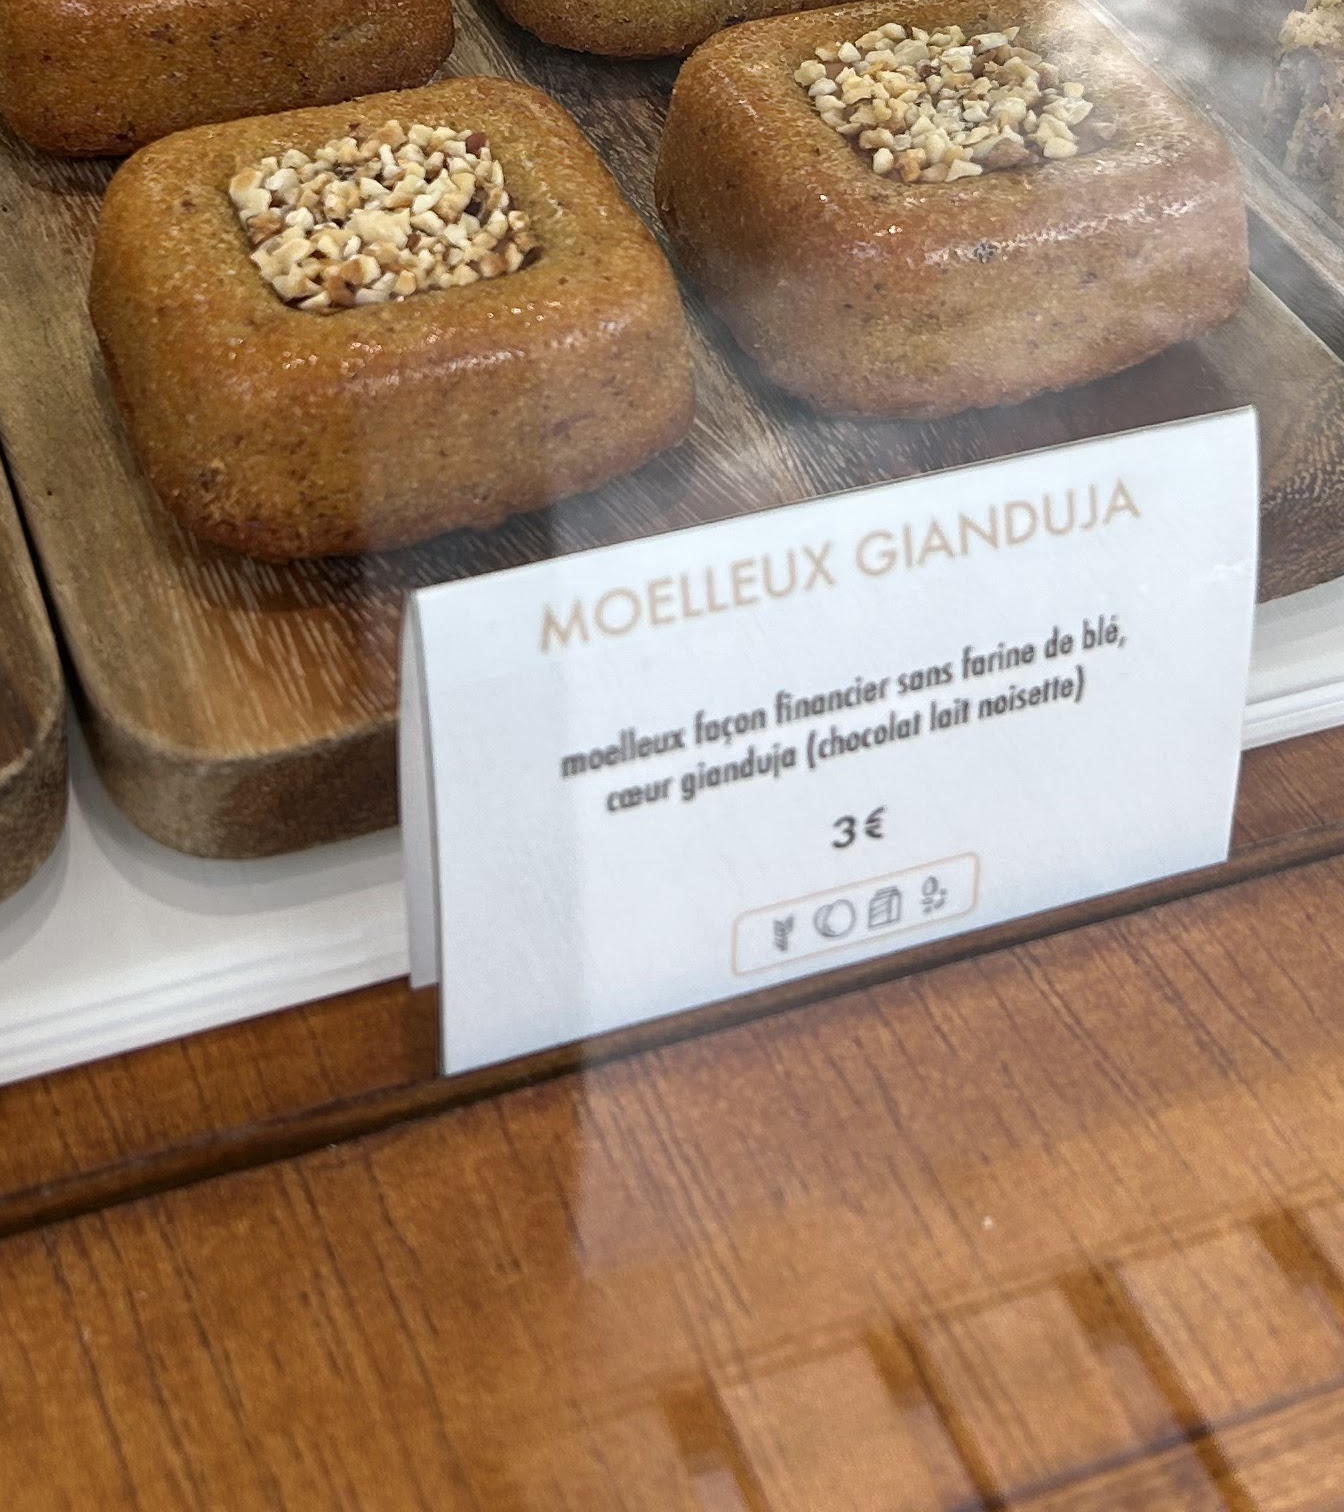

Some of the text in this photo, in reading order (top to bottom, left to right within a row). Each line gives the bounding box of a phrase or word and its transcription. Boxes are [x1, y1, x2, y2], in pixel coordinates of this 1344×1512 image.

[538, 476, 1142, 655] MOELLEUX GIANDUJA
[560, 614, 1128, 779] moelleux façon financier sans farine de blé,
[606, 664, 1085, 812] cœur gianduja (chocolat lait noisette)
